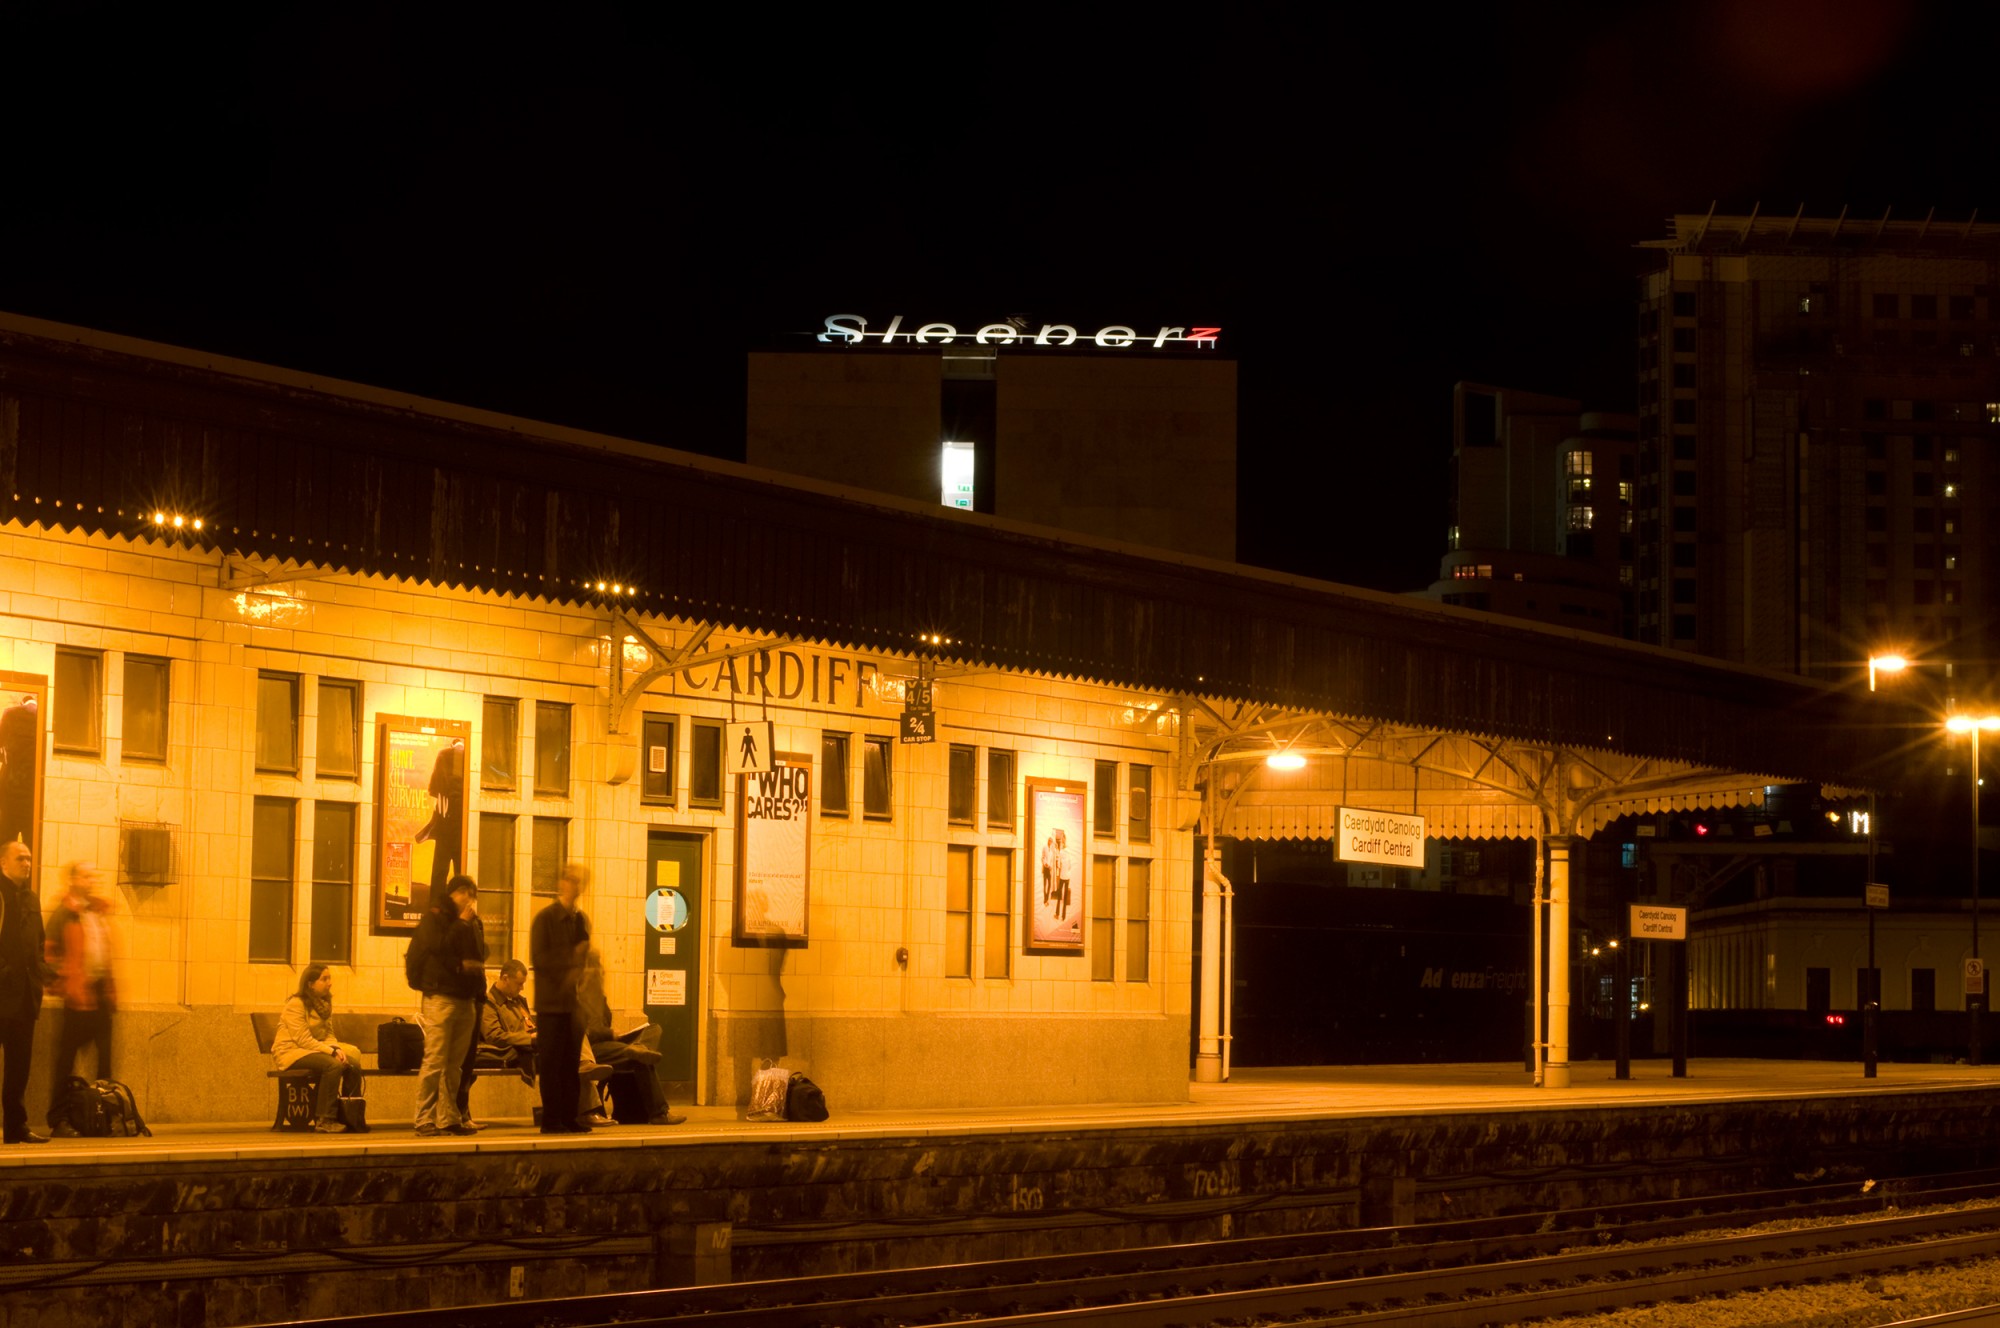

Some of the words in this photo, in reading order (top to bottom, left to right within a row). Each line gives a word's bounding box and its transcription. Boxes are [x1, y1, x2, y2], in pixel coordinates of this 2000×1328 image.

[817, 313, 1222, 347] Sleeperz
[682, 640, 878, 708] CARDIFF
[906, 689, 931, 706] 4/5
[909, 716, 926, 735] 2/4
[387, 787, 430, 809] SURVIVE.
[1344, 814, 1386, 835] Caerdydd
[1387, 818, 1421, 840] Canolog
[1352, 836, 1382, 855] Cardiff
[1383, 839, 1414, 858] Central
[1639, 910, 1660, 920] Caerdydd
[1660, 911, 1677, 922] Canolog
[1642, 922, 1658, 932] Cardiff
[1658, 923, 1673, 933] Central
[287, 1103, 310, 1119] (W)
